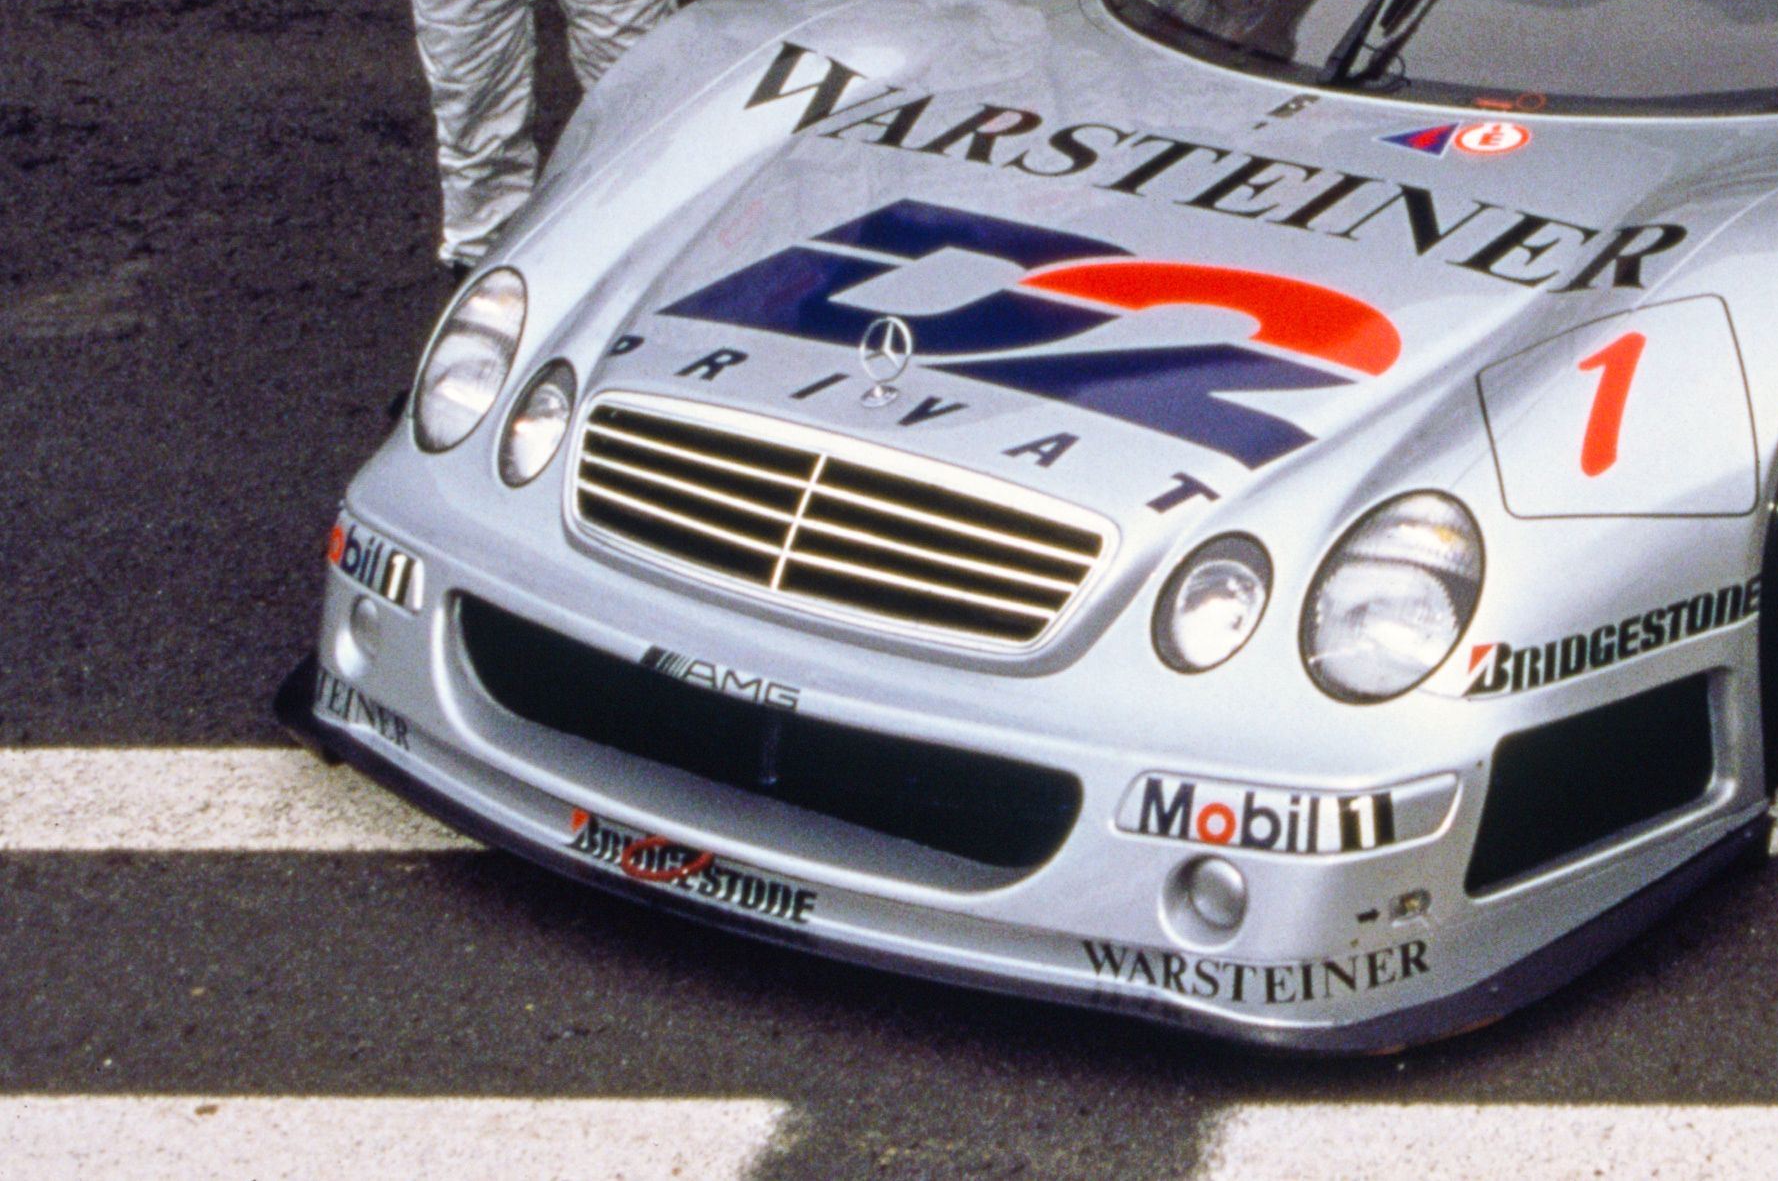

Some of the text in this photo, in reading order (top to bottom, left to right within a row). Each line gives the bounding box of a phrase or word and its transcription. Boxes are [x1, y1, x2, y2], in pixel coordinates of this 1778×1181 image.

[744, 39, 1688, 295] WARSTEINER
[653, 196, 1402, 473] D2
[1577, 330, 1648, 478] 1
[608, 333, 1222, 517] PRIVAT
[682, 659, 801, 713] AMG
[1138, 776, 1320, 854] Mobil
[1081, 936, 1431, 1006] WARSTEINER
